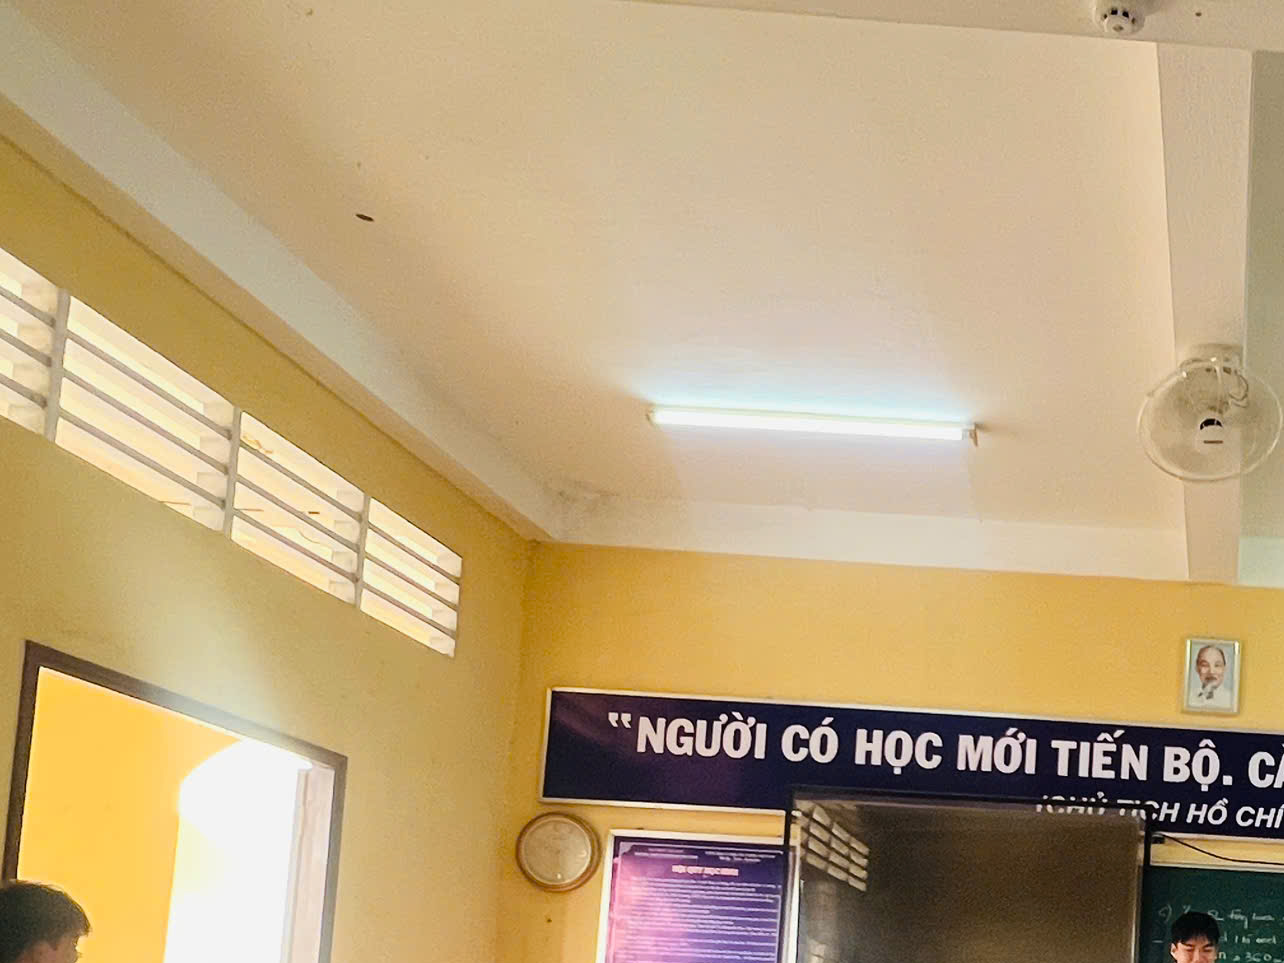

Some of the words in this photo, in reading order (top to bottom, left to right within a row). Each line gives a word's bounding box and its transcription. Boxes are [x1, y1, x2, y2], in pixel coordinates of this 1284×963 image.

[781, 717, 839, 763] CÓ
[854, 728, 943, 775] HỌC
[957, 728, 1037, 775] MỚI
[1051, 729, 1148, 781] TIẾN
[1163, 739, 1233, 792] BỘ.
[1186, 798, 1228, 826] HỒ
